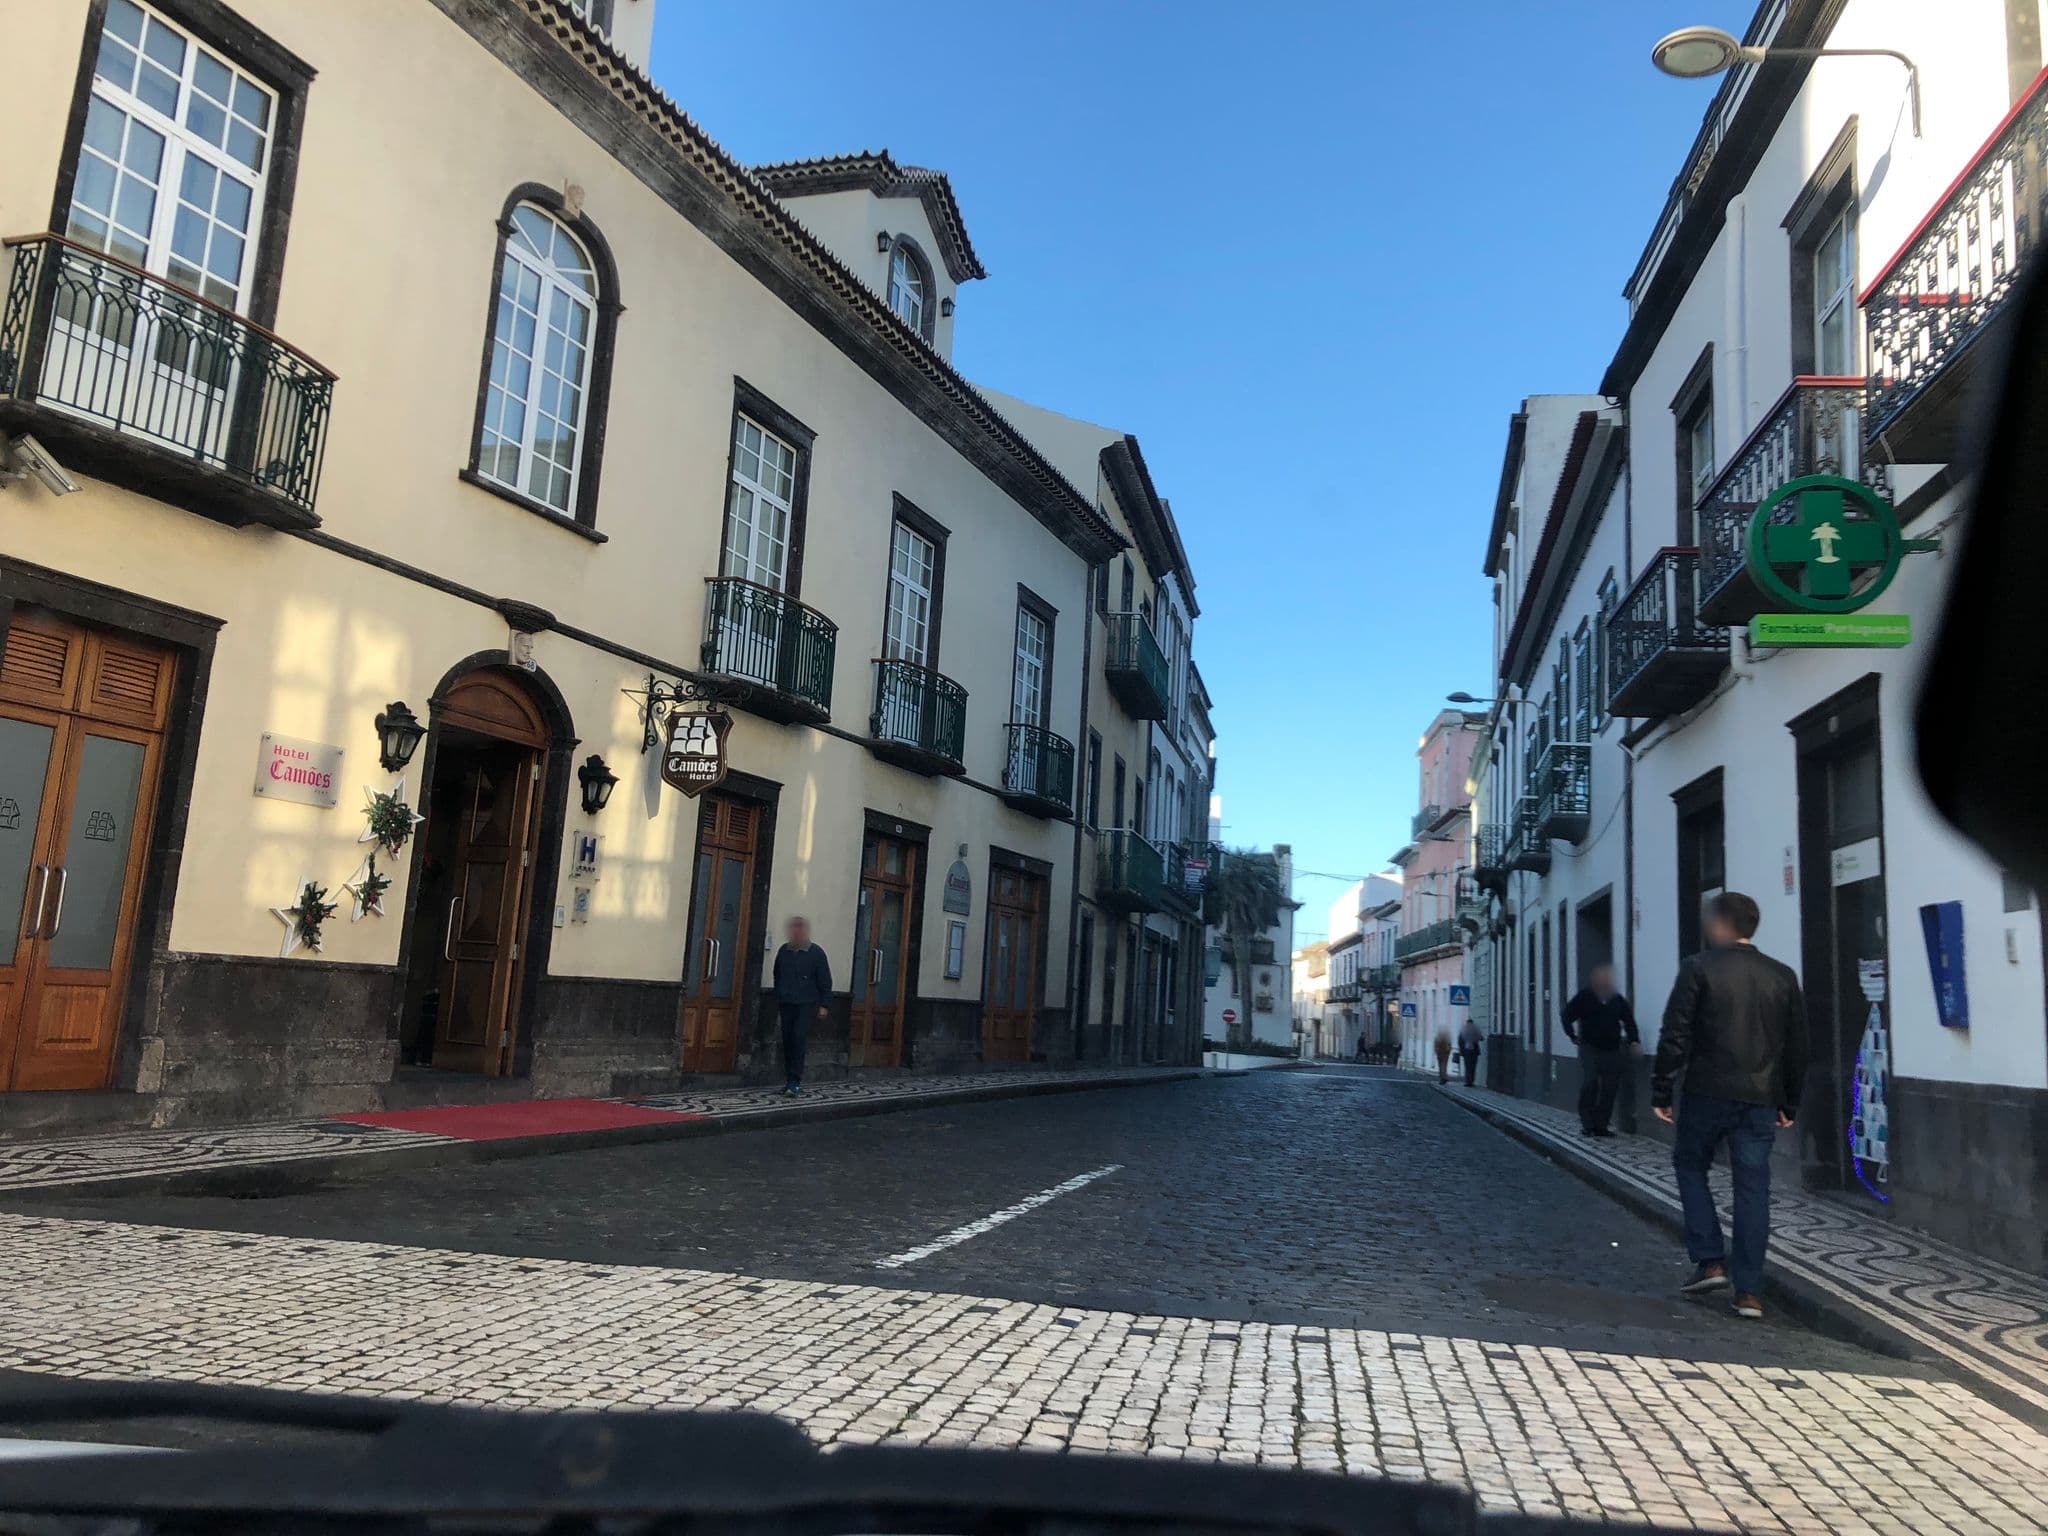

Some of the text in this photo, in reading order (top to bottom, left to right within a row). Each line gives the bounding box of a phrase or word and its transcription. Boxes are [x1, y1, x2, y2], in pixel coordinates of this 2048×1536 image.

[273, 744, 310, 760] Hotel
[270, 759, 333, 788] Camões
[668, 757, 719, 772] Camões
[580, 836, 597, 864] H
